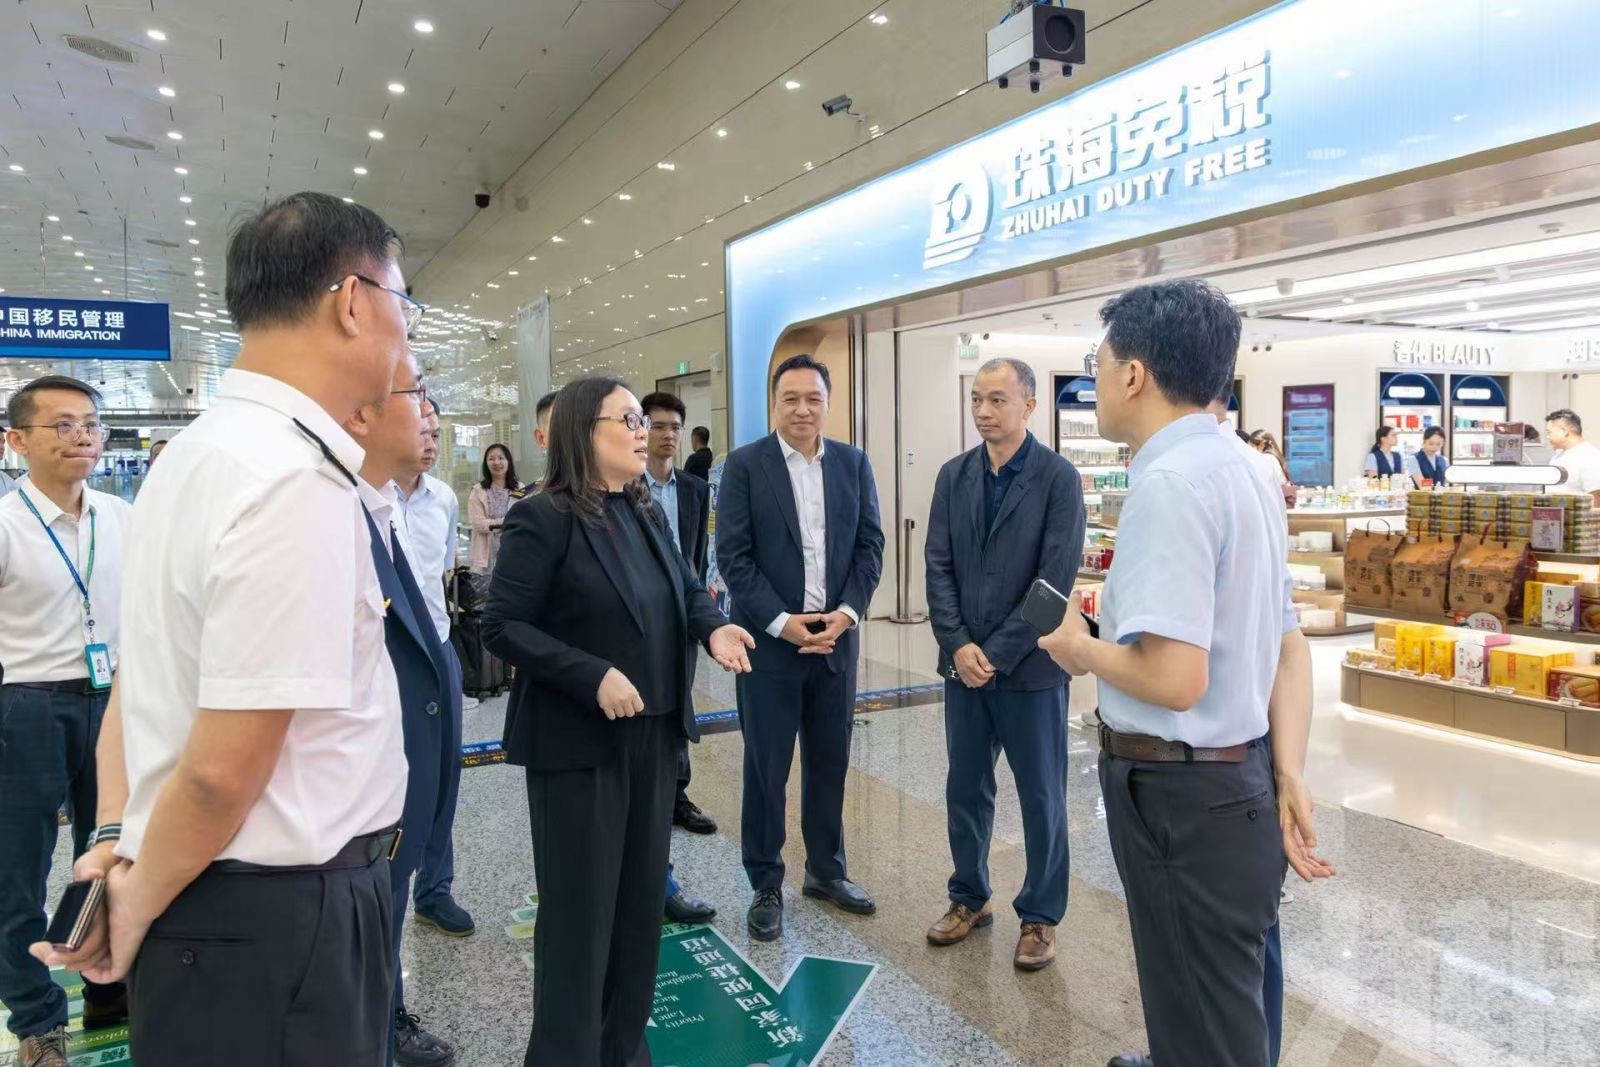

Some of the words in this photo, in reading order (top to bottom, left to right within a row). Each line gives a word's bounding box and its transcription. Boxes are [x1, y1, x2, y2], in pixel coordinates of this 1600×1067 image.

[1003, 48, 1271, 210] 珠海免税
[1002, 195, 1088, 239] ZHUHAI
[1098, 167, 1173, 212] DUTY
[1185, 138, 1271, 187] FREE
[0, 327, 32, 338] HINA
[36, 329, 121, 340] IMMIGRATION
[1431, 342, 1495, 366] BEAUTY
[652, 995, 680, 1004] Maca
[680, 936, 805, 1048] 新家园便捷通道
[653, 1005, 669, 1014] for
[658, 1010, 685, 1021] Lane
[665, 1013, 705, 1028] Priority
